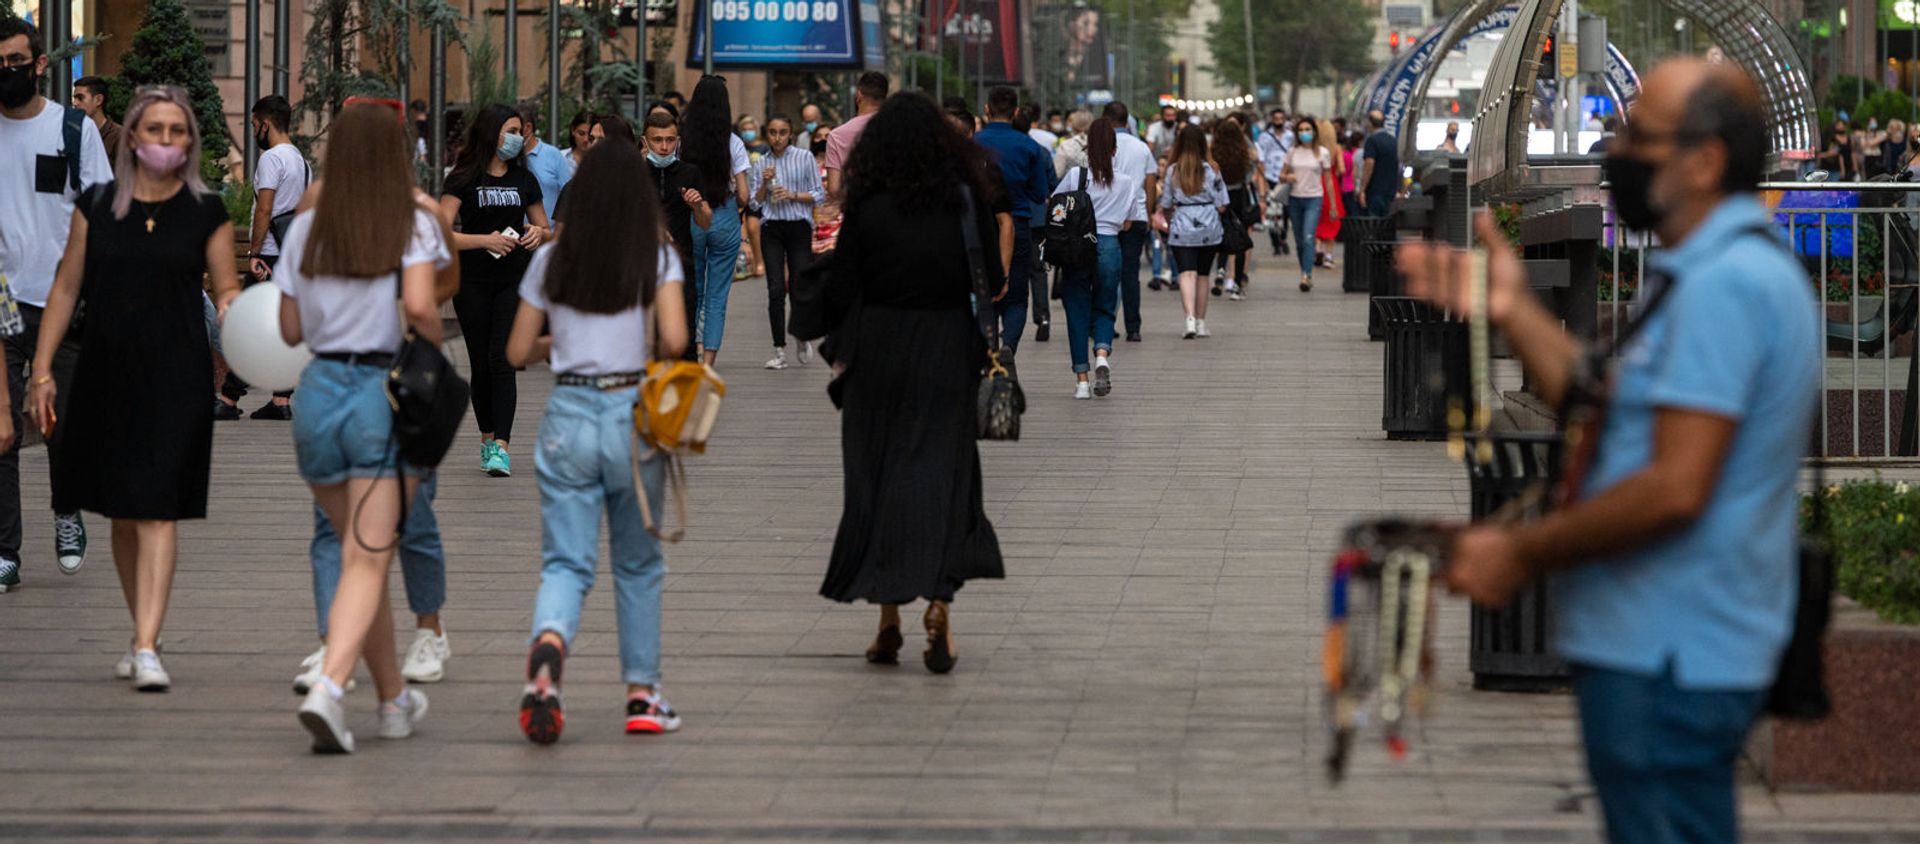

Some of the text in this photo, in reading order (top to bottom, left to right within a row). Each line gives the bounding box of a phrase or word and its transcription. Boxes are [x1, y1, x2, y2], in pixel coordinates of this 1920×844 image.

[712, 1, 838, 22] 095 00 00 80
